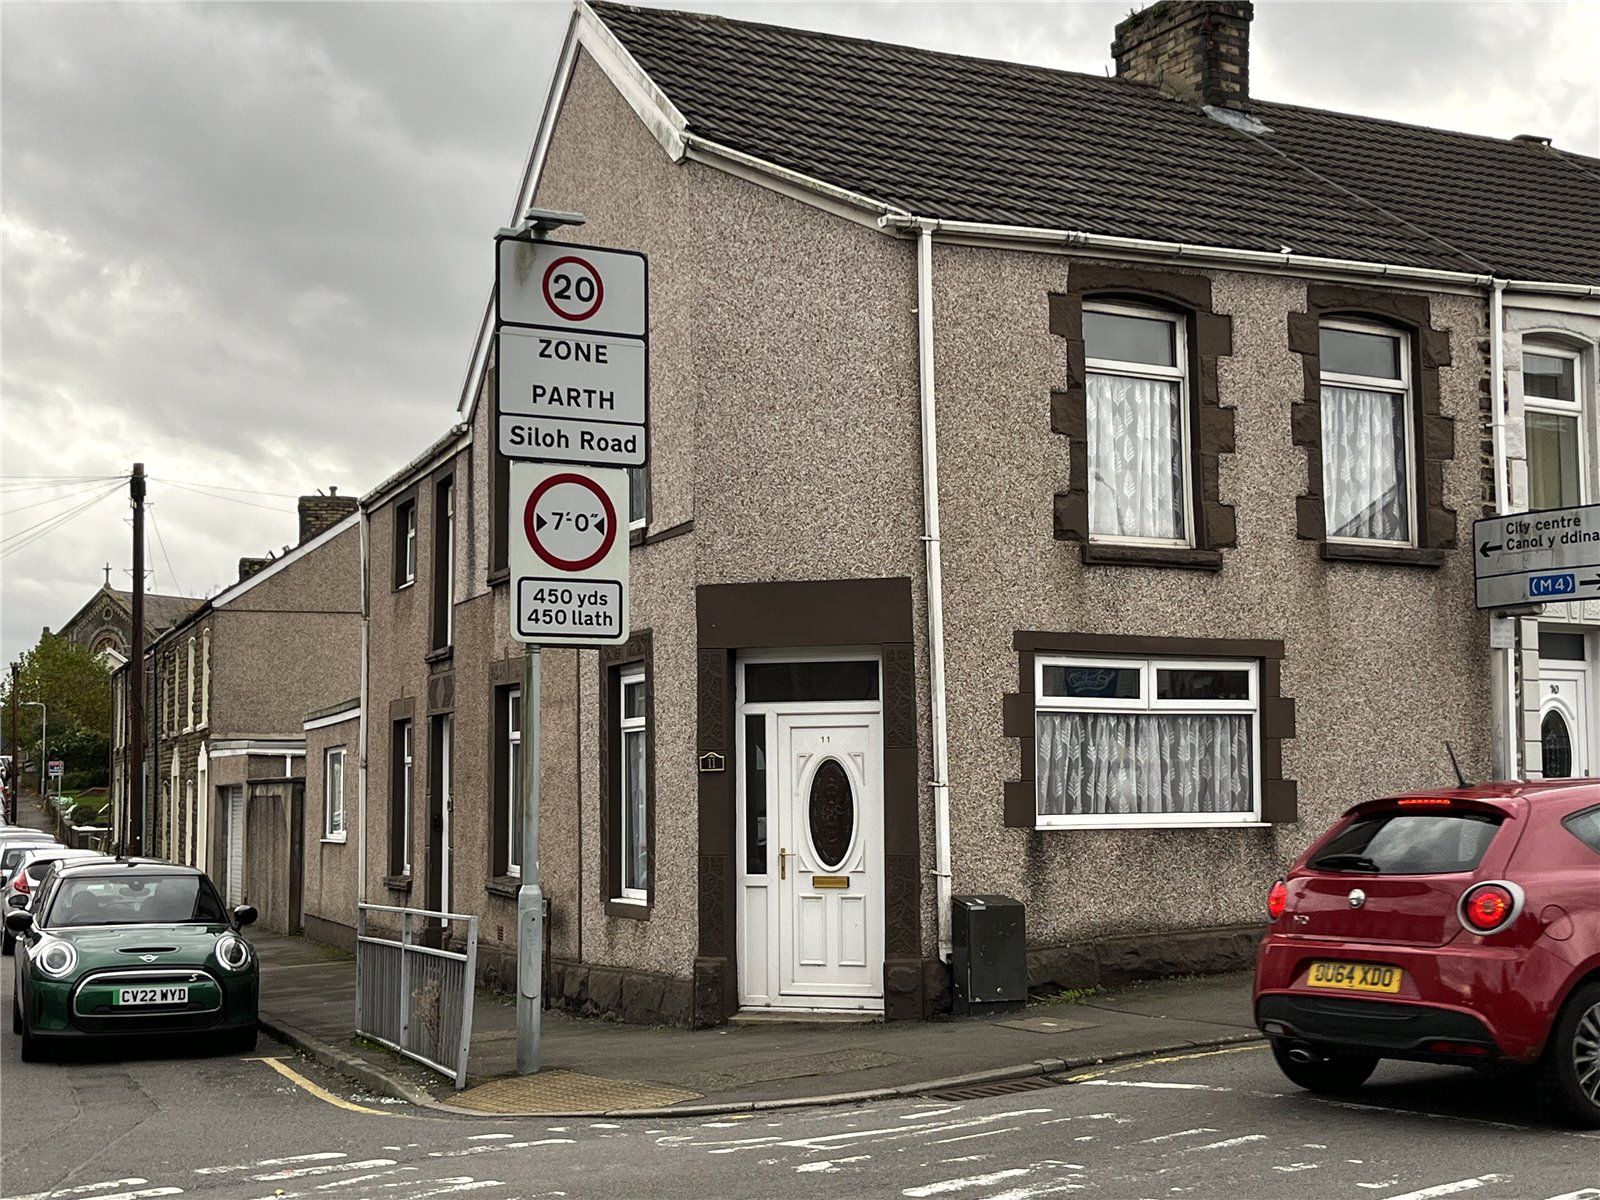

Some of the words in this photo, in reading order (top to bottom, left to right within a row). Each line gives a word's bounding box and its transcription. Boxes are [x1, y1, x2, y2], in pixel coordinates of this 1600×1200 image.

[553, 274, 595, 303] 20
[539, 338, 609, 364] ZONE
[532, 384, 615, 411] PARTH
[509, 425, 570, 449] Siloh
[580, 430, 637, 453] Road
[1506, 521, 1530, 535] City
[1535, 515, 1581, 531] centre
[1506, 535, 1543, 550] Canol
[1548, 536, 1555, 548] y
[1561, 530, 1600, 544] ddina
[1531, 575, 1573, 594] (M4)
[533, 588, 573, 605] 450
[577, 590, 608, 608] yds
[527, 608, 567, 625] 450
[572, 609, 613, 627] llath
[121, 989, 157, 1003] CV22
[160, 988, 186, 1002] WYD
